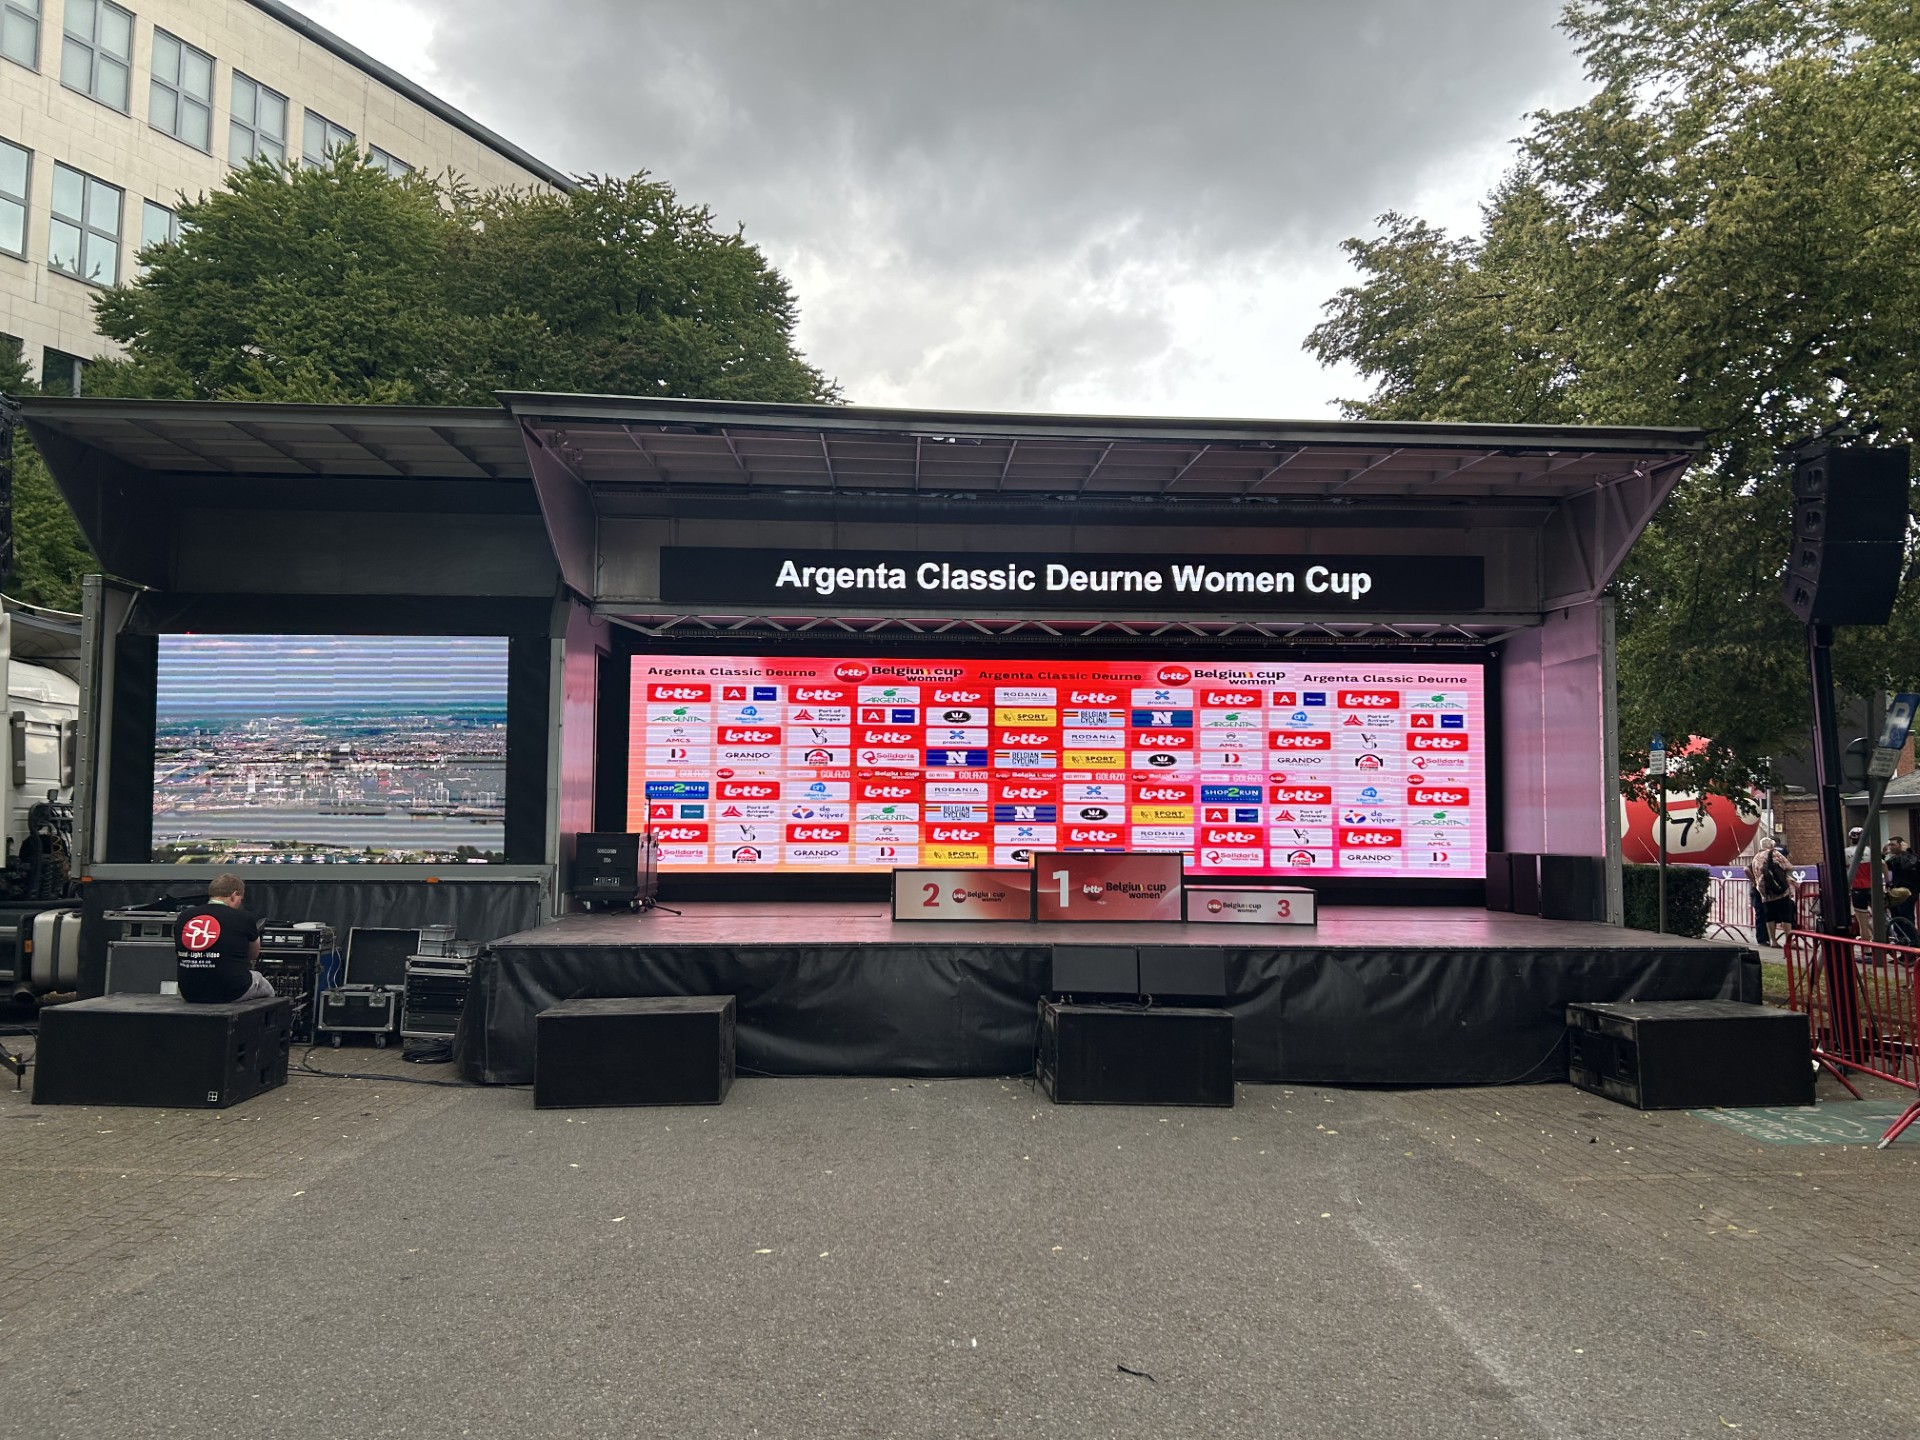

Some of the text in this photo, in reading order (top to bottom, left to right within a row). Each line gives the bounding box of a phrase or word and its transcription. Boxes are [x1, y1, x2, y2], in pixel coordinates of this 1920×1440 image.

[776, 561, 1371, 600] Argenta Classic Deurne Women Cup
[648, 667, 816, 677] Argenta Classic Deurne
[934, 668, 963, 676] cup
[979, 672, 1033, 680] Argenta
[1257, 671, 1286, 680] cup
[1303, 675, 1359, 683] Argenta
[1363, 675, 1413, 683] Classic
[728, 689, 740, 698] A
[1417, 717, 1428, 725] A
[650, 783, 705, 793] SHOP2RUN
[1205, 788, 1258, 797] SHOP2RUN
[1671, 818, 1694, 846] 7
[1052, 870, 1069, 908] 1
[1147, 883, 1166, 893] cup
[923, 883, 940, 907] 2
[1278, 900, 1290, 917] 3
